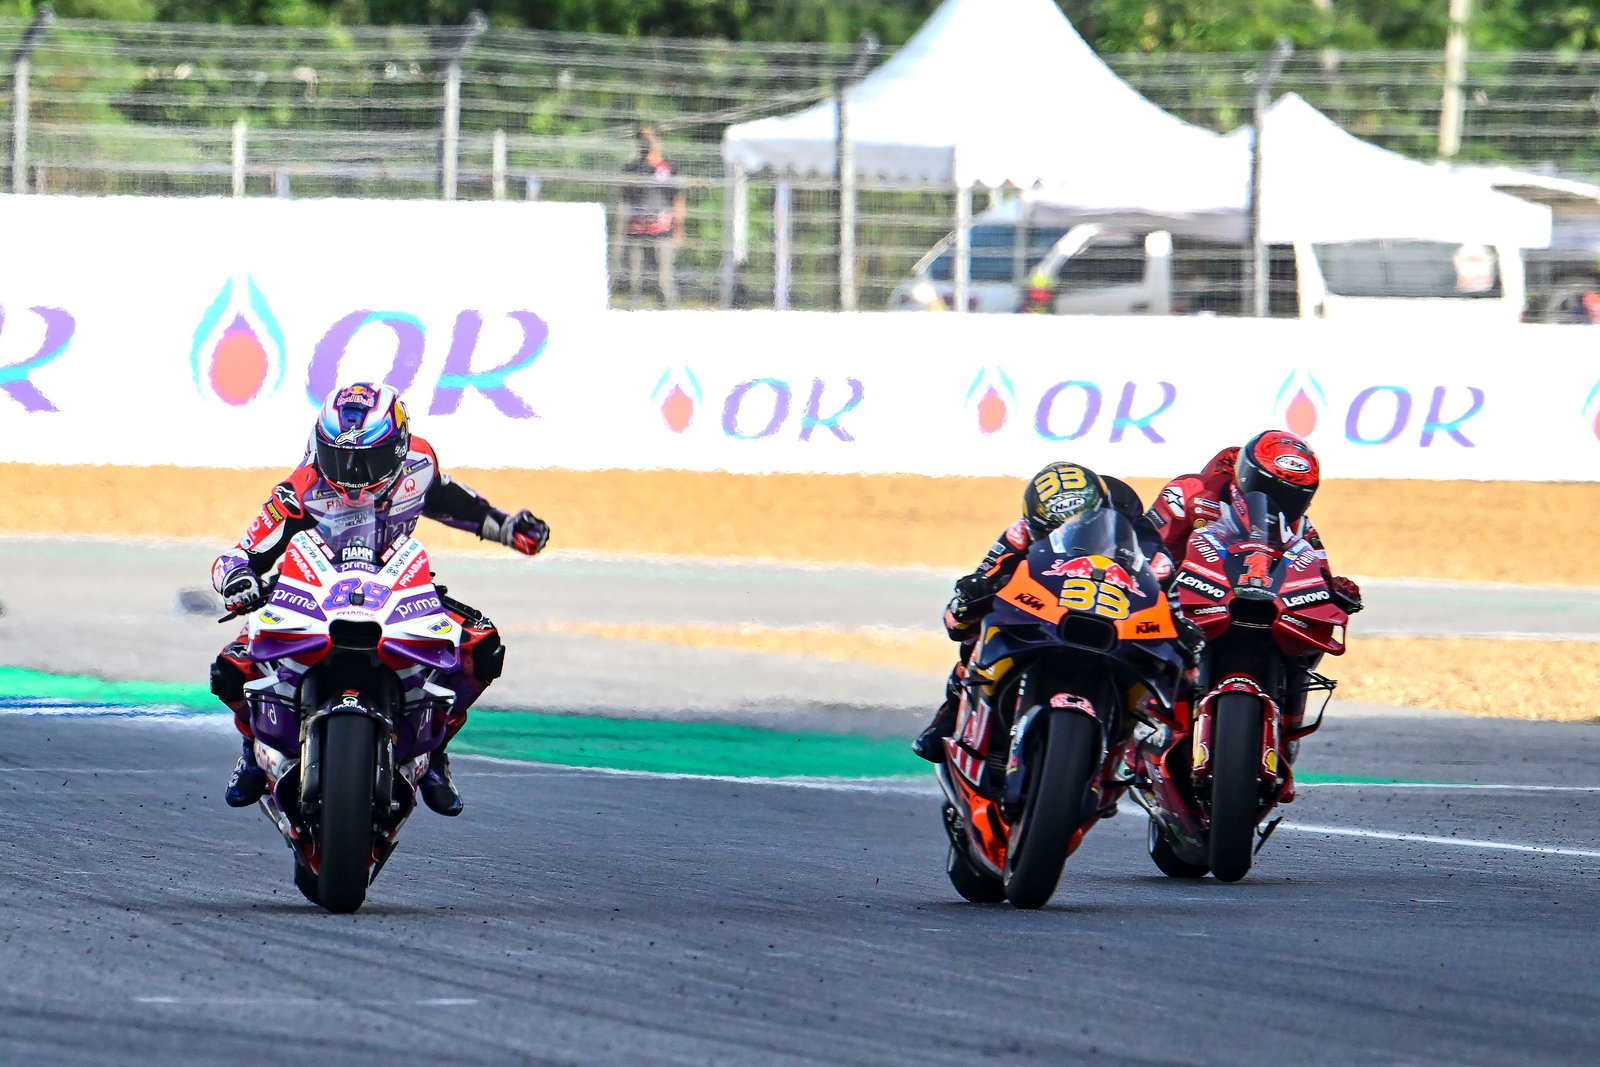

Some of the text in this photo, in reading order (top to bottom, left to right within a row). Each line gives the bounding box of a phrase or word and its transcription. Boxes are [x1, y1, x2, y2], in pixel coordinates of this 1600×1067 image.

[305, 309, 549, 419] OR
[721, 376, 865, 443] OR
[1034, 380, 1177, 444] OR
[1344, 385, 1485, 448] OR
[1034, 467, 1087, 502] 33
[287, 548, 316, 583] PRAMAC
[340, 560, 375, 573] prima
[341, 546, 374, 562] FIAMM
[398, 555, 427, 588] PRAMAC
[1176, 571, 1226, 598] Lenovo
[1237, 551, 1274, 588] 1
[271, 588, 318, 612] prima
[321, 577, 393, 612] 89
[394, 596, 441, 619] prima
[1014, 593, 1047, 611] KTM
[1058, 578, 1131, 620] 33
[1282, 589, 1330, 608] Lenovo
[336, 610, 376, 619] PRAMAC
[1135, 621, 1161, 634] KTM
[331, 702, 369, 714] PRAMAC
